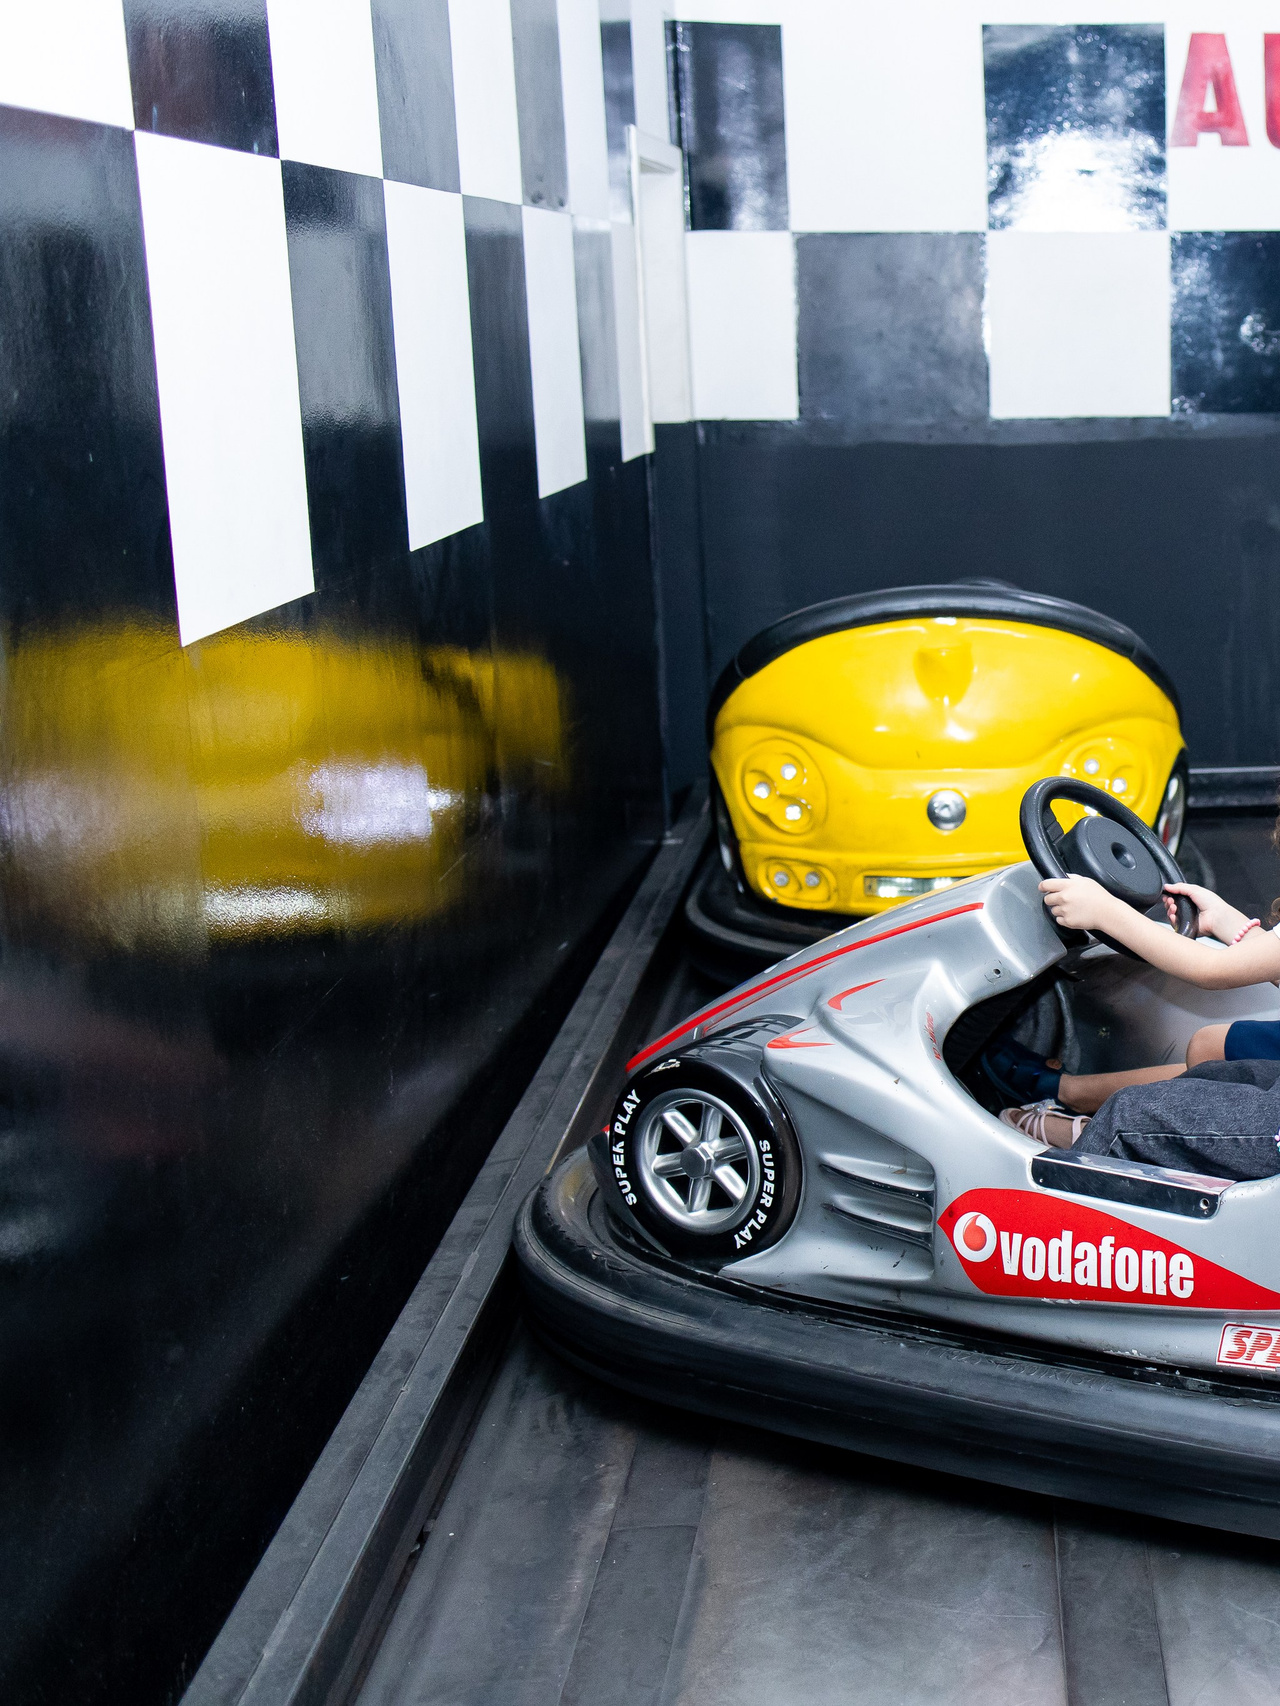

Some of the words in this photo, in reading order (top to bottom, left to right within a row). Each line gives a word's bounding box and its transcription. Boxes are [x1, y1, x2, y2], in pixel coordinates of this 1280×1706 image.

[614, 1089, 641, 1135] PLAY
[612, 1141, 638, 1206] SUPER
[758, 1139, 776, 1208] SUPER
[734, 1210, 767, 1250] PLAY
[999, 1230, 1195, 1299] vodafone
